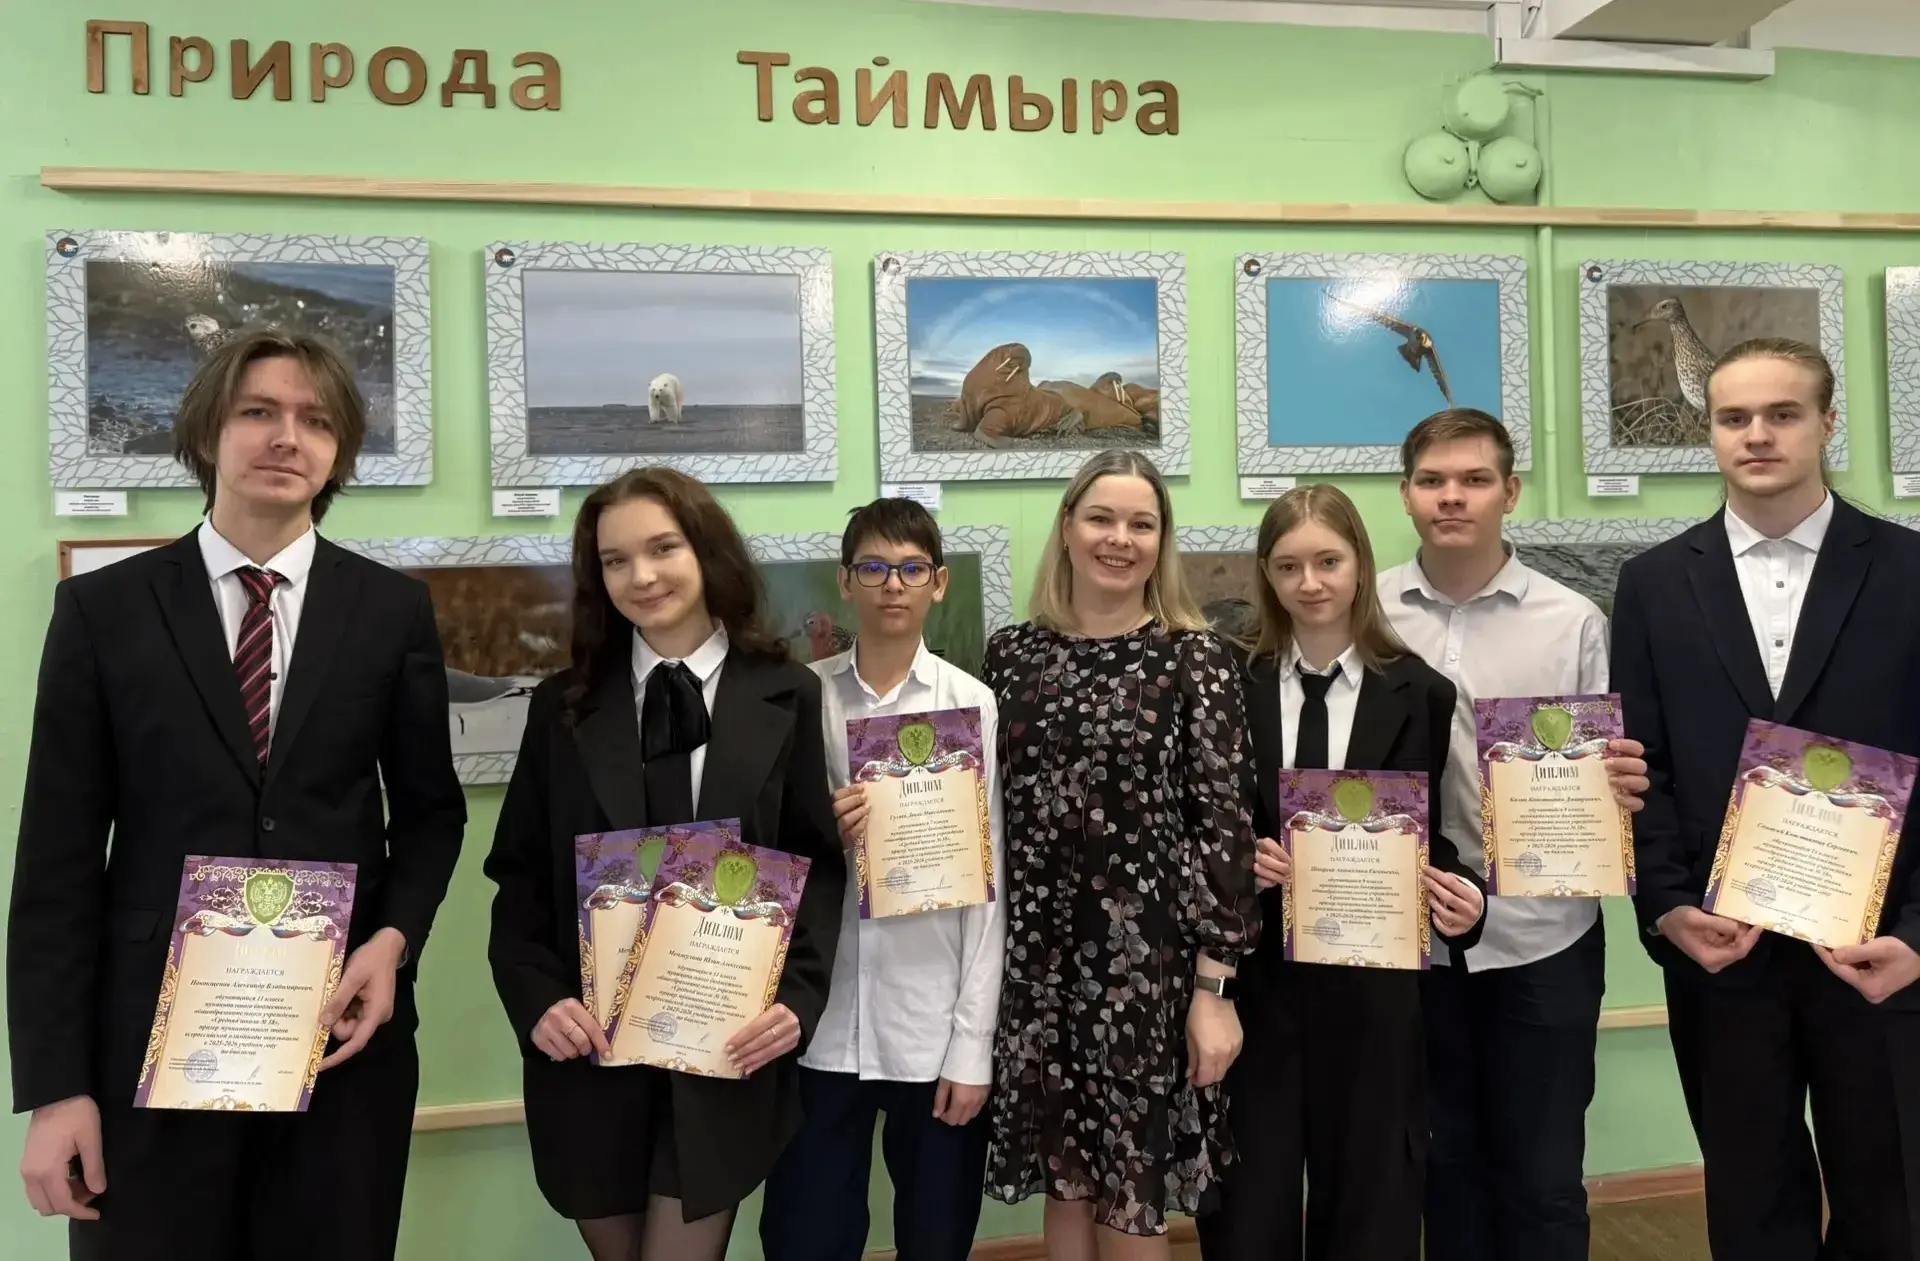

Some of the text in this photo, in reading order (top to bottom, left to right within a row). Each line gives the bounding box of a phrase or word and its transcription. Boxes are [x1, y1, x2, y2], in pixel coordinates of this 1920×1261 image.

[85, 19, 1181, 136] Природа Таймыра
[899, 797, 944, 808] НАГРАЖДАЕТСЯ
[1781, 817, 1838, 837] НАГРАЖДАЕТСЯ
[689, 940, 739, 955] НАГРАЖДАЕТСЯ
[225, 967, 285, 976] НАГРАЖДАЕТСЯ
